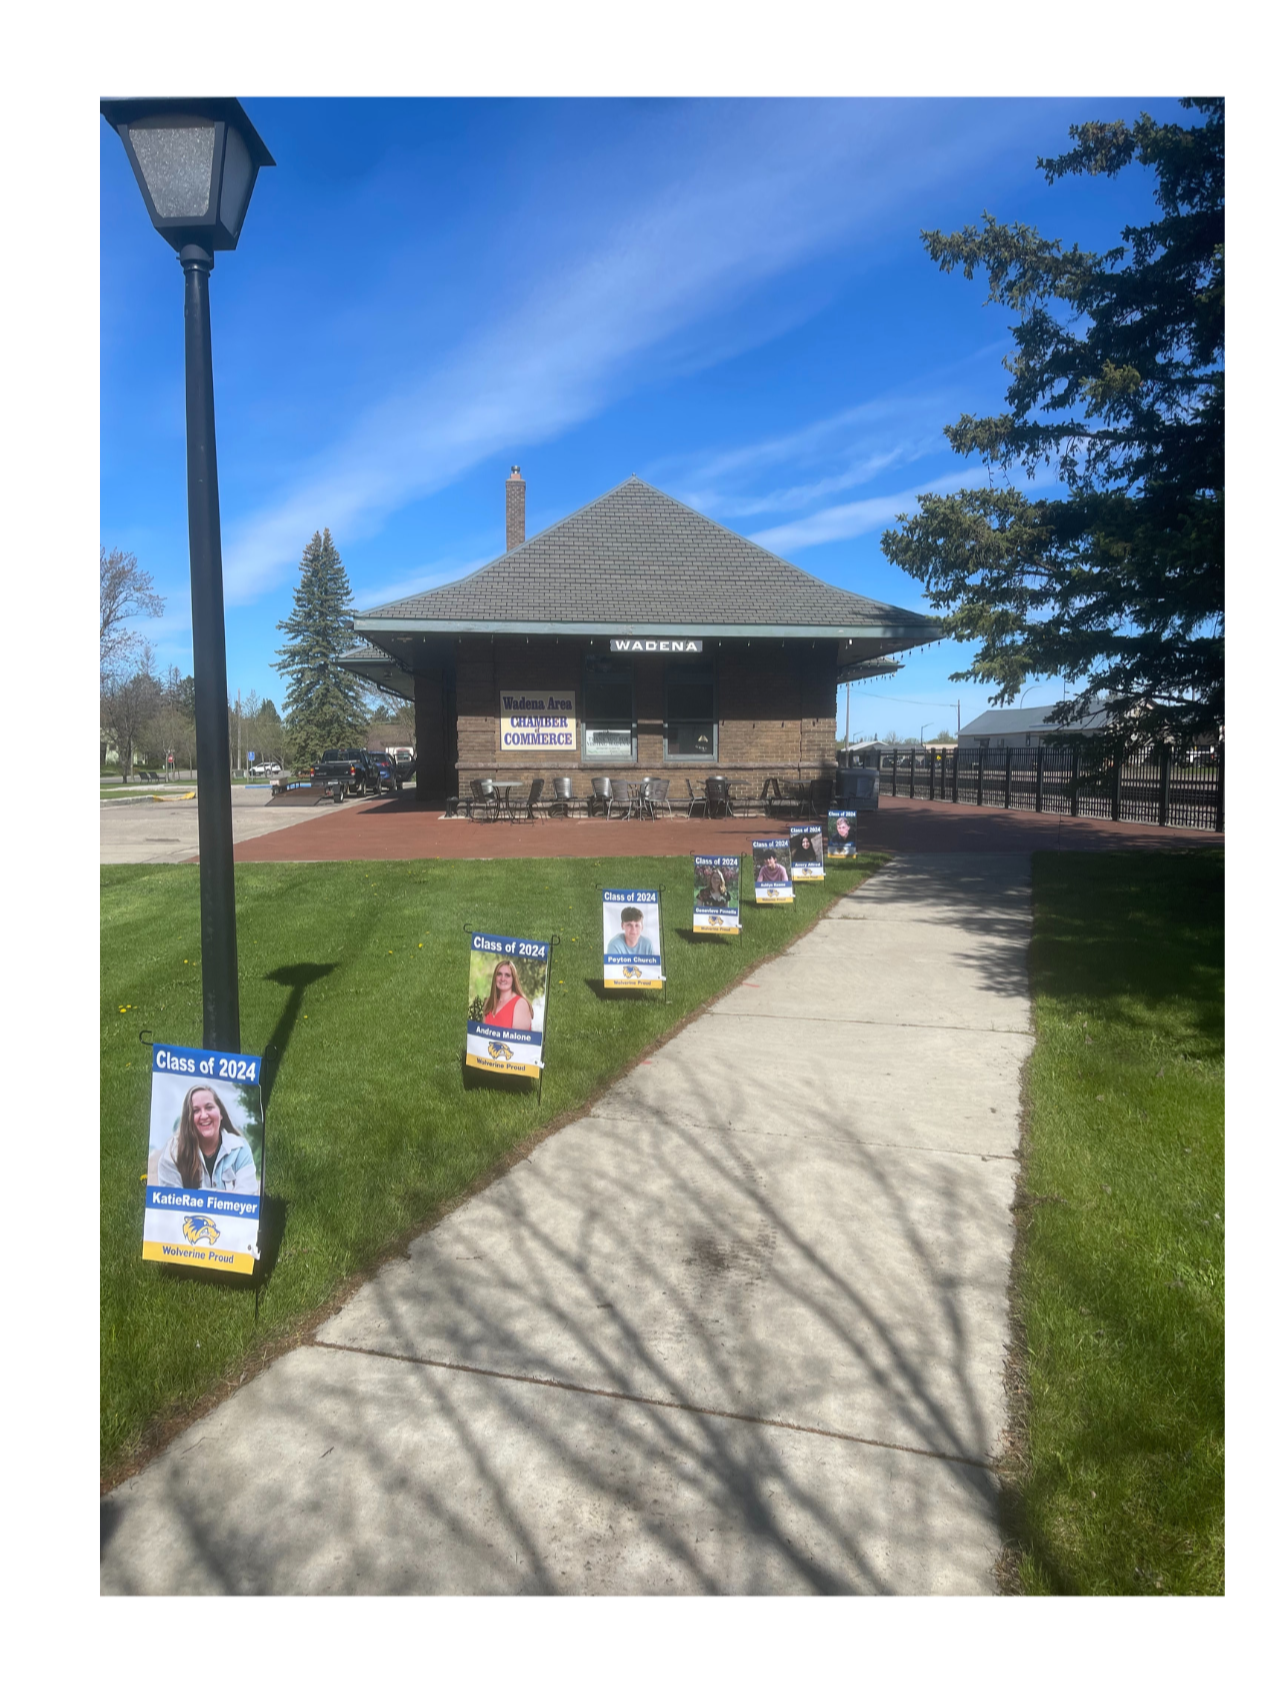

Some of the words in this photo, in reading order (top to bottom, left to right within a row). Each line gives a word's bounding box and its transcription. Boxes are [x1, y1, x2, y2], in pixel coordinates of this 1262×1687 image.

[615, 640, 698, 651] WADENA
[503, 696, 545, 710] Wadena
[547, 696, 572, 710] Area
[510, 716, 568, 728] CHAMBER
[504, 732, 572, 746] COMMERCE
[696, 857, 712, 865] Class
[722, 858, 738, 866] 2024
[604, 892, 625, 901] Class
[627, 892, 634, 901] of
[637, 892, 656, 902] 2024
[474, 936, 502, 951] Class
[505, 940, 516, 953] of
[519, 943, 545, 958] 2024
[608, 956, 631, 965] Peyton
[476, 1026, 501, 1038] Andrea
[502, 1030, 532, 1042] Malone
[156, 1050, 196, 1073] Class
[200, 1057, 214, 1075] of
[219, 1058, 256, 1081] 2024
[476, 1057, 504, 1069] Wolverine
[506, 1063, 526, 1072] Proud
[152, 1192, 204, 1208] KatieRae
[207, 1196, 258, 1214] Fiemeyer
[162, 1245, 205, 1260] Wolverine
[208, 1252, 234, 1264] Proud
